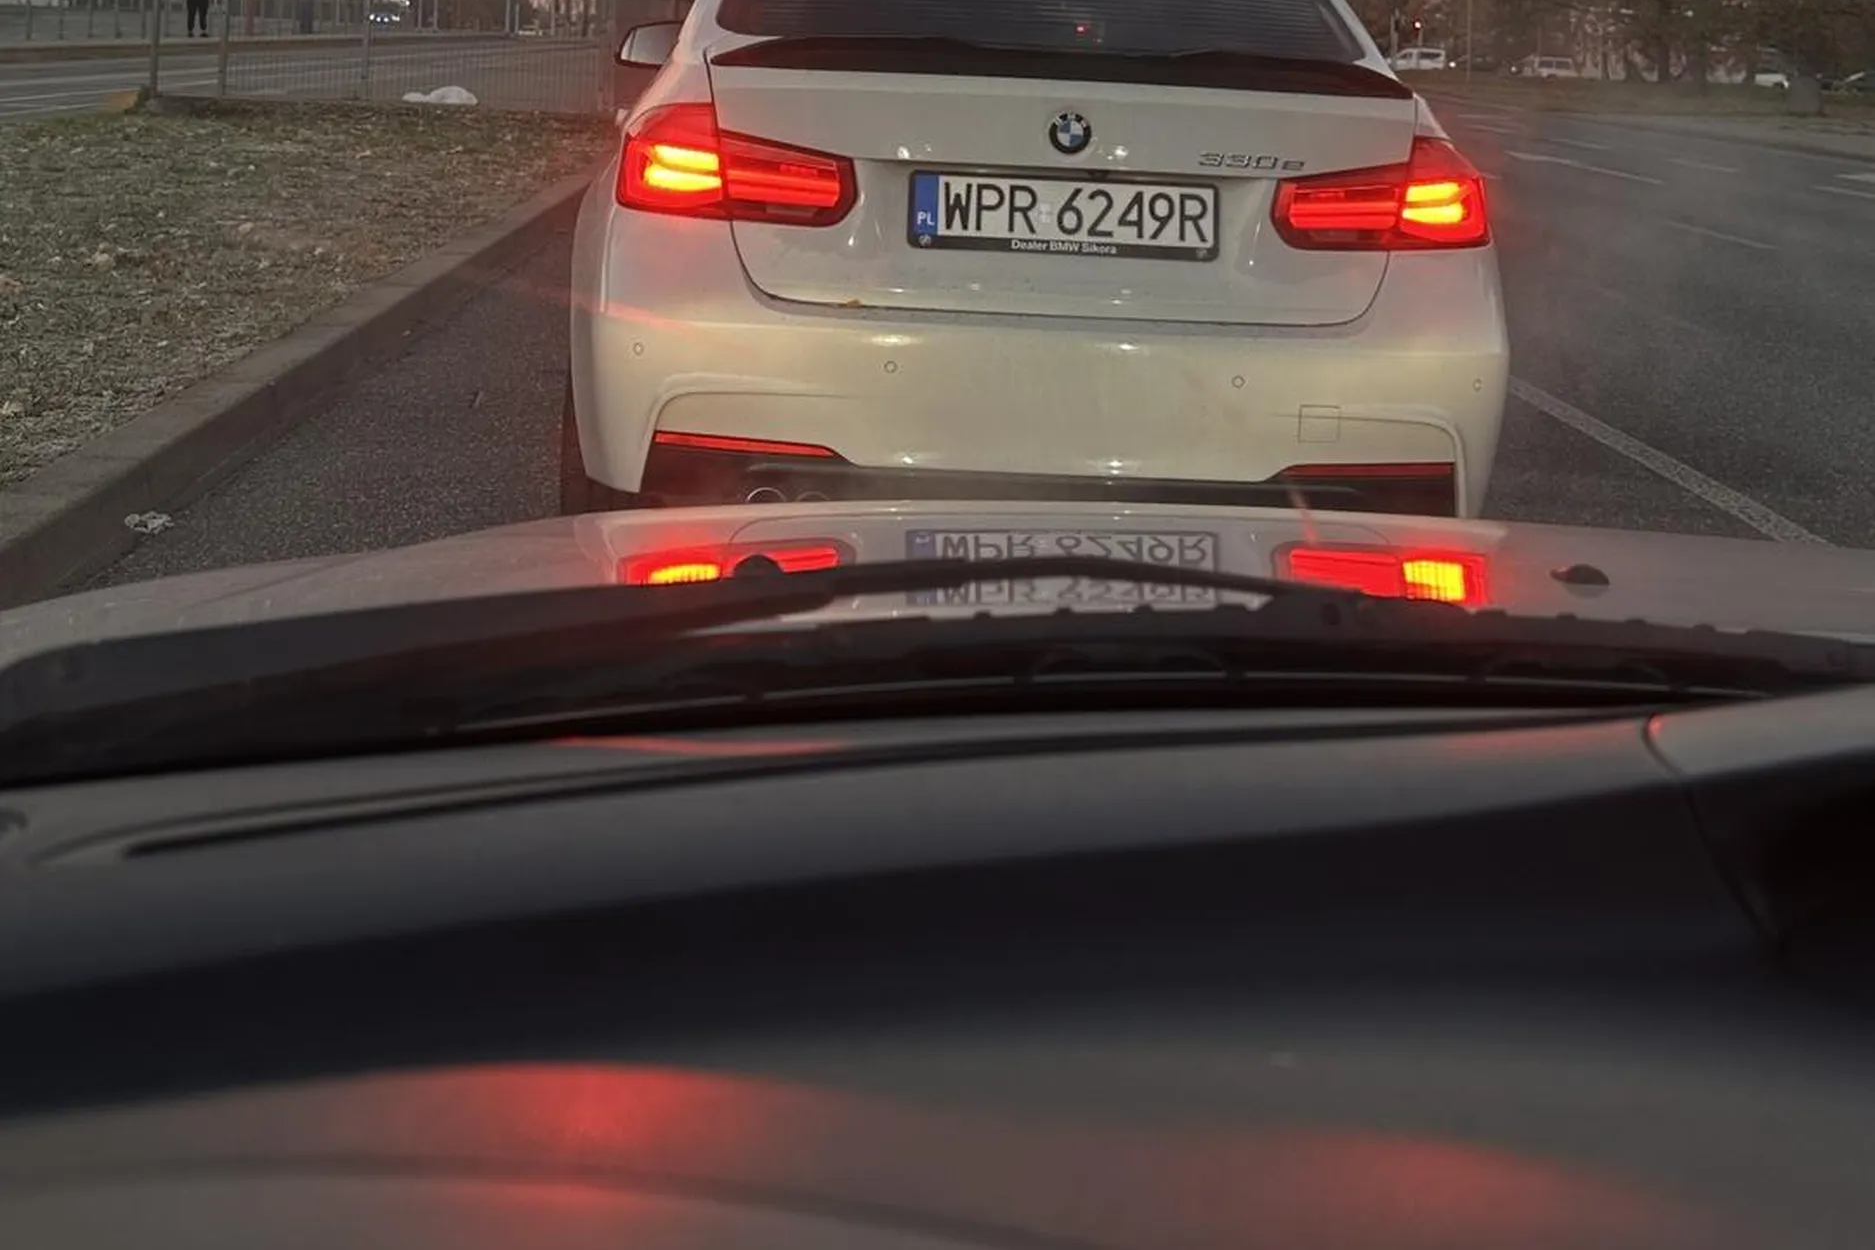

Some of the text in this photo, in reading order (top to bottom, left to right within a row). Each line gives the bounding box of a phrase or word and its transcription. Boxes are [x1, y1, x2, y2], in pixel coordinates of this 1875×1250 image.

[1198, 152, 1306, 171] 330e
[916, 211, 935, 226] PL
[943, 182, 1208, 243] WPR 6249R
[1011, 239, 1117, 255] Dealer BMW Sikora
